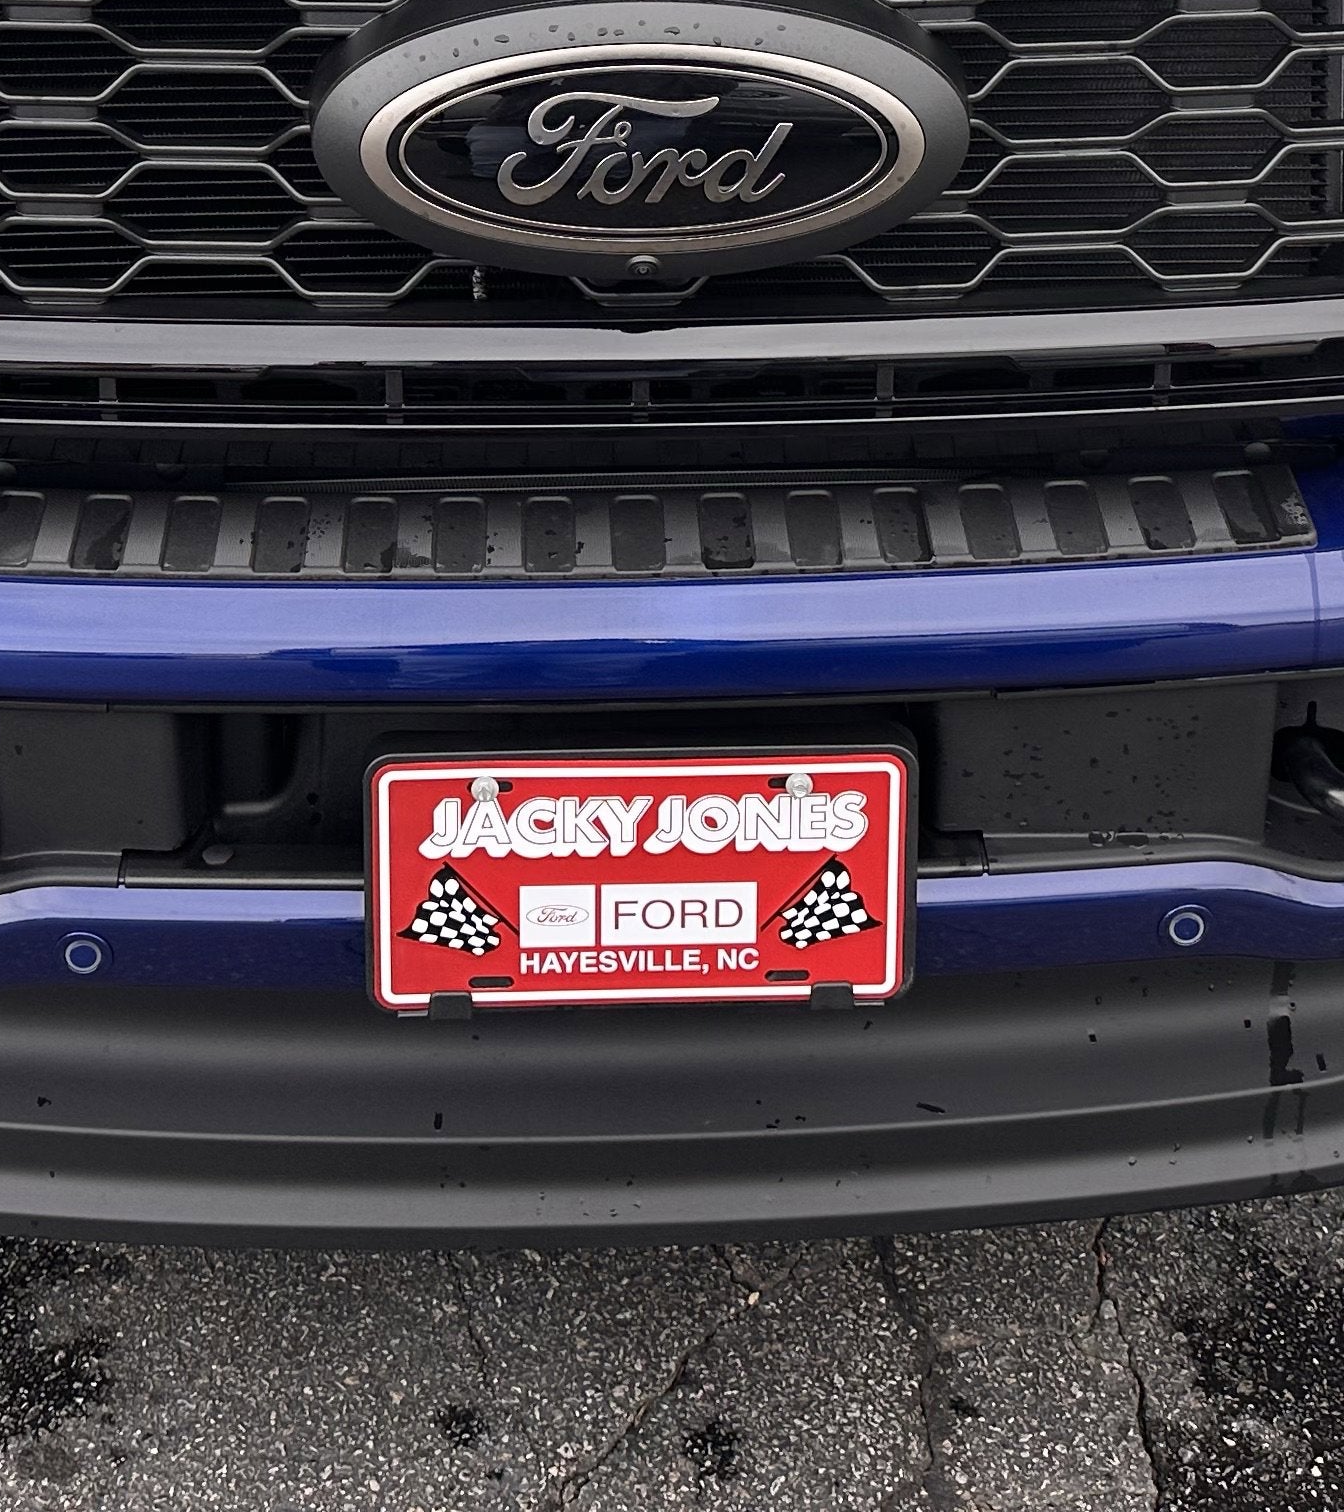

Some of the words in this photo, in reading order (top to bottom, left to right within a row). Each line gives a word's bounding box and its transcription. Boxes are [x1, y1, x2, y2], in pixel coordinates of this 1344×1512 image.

[497, 91, 794, 206] Ford
[419, 796, 654, 858] JACKY
[643, 791, 869, 854] JONES
[536, 906, 578, 924] Ford
[613, 898, 744, 930] FORD
[519, 948, 709, 974] HAYESVILLE,
[716, 946, 760, 971] NC
